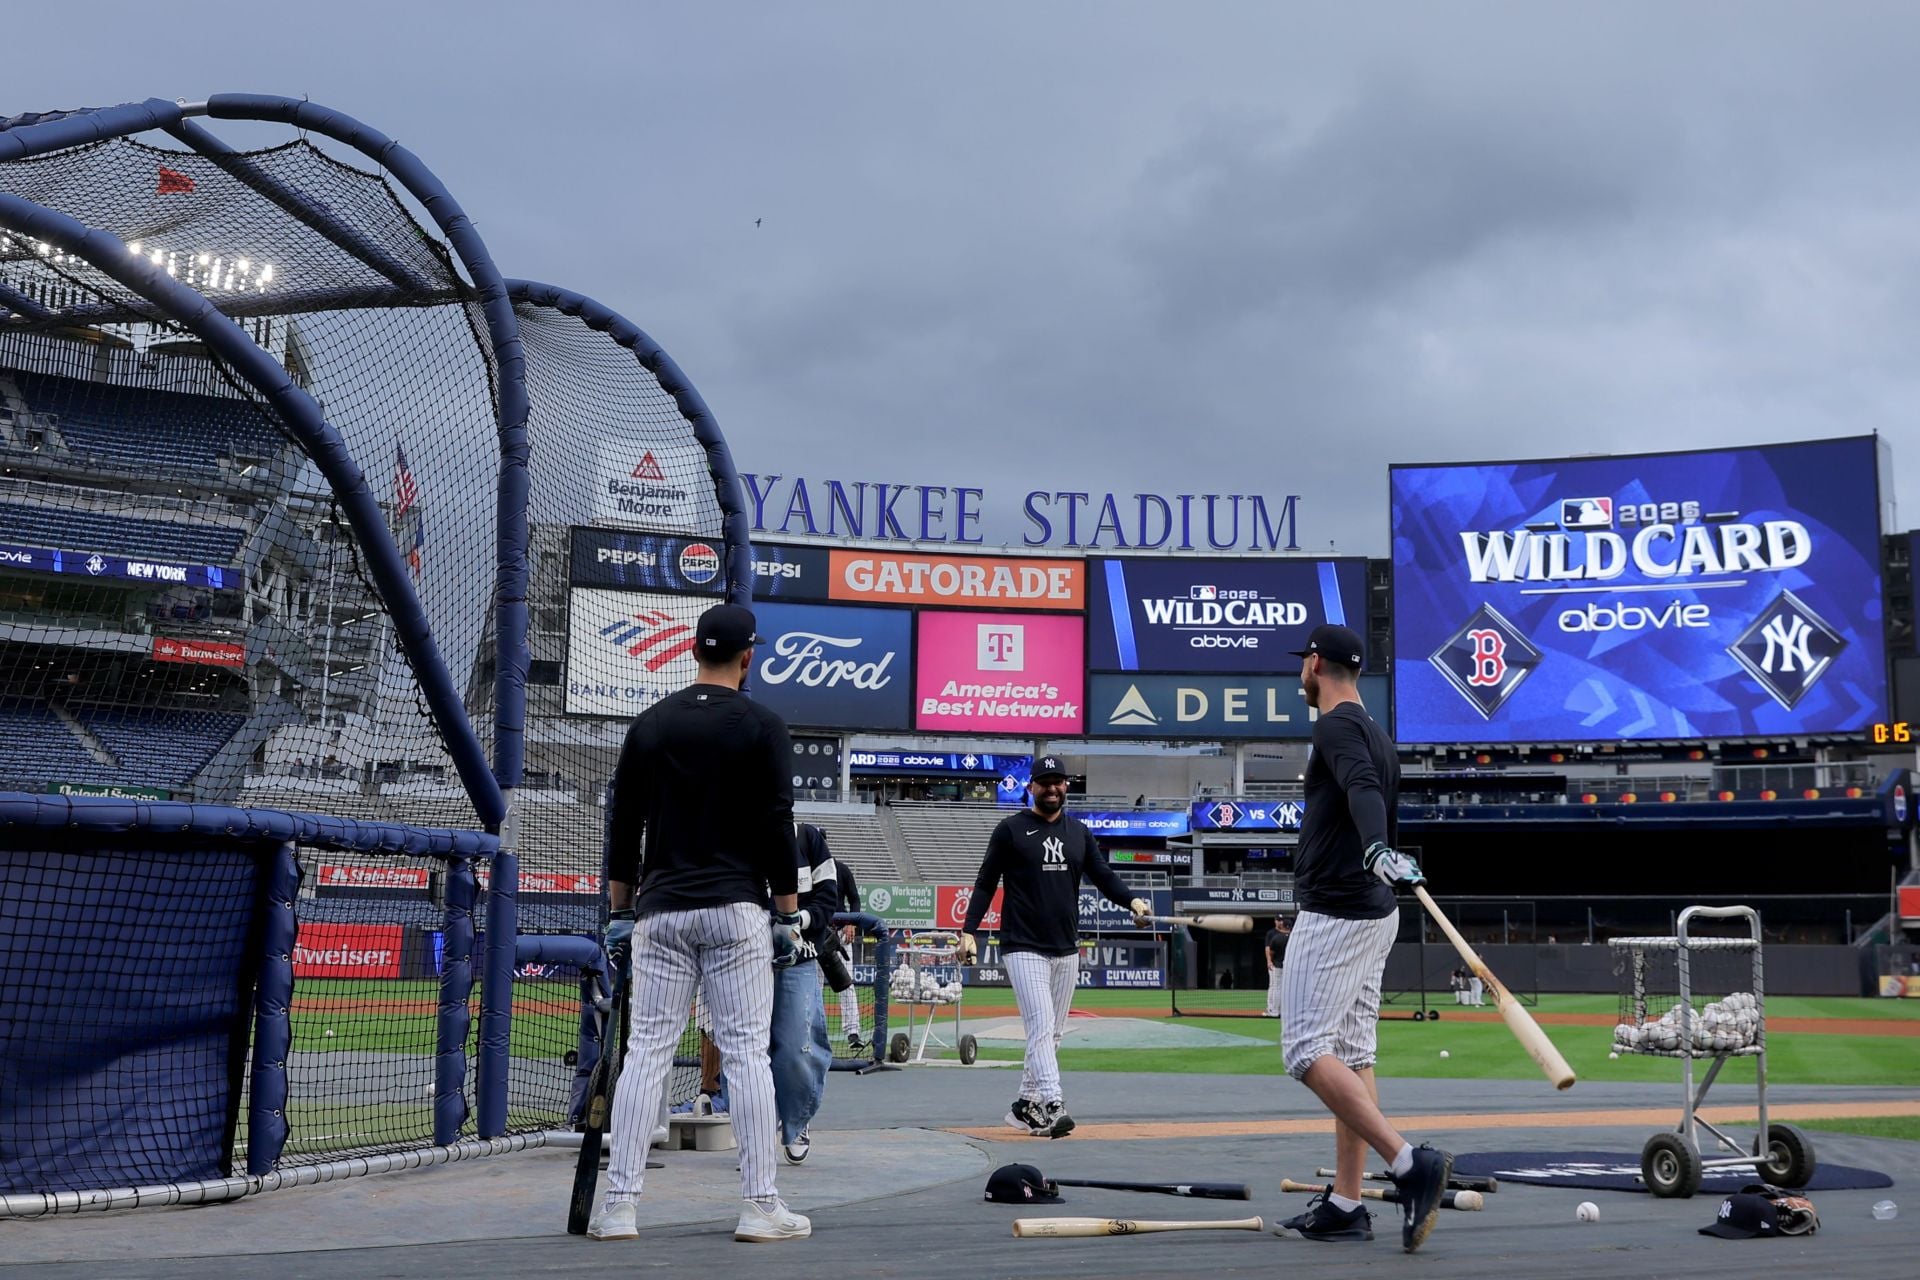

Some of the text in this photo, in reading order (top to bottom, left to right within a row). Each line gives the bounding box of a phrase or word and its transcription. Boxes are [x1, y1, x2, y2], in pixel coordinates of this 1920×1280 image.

[608, 479, 686, 501] Benjamin
[617, 497, 672, 517] Moore
[738, 473, 1303, 551] YANKEE STADIUM
[1619, 501, 1701, 524] 2026
[597, 547, 656, 566] PEPSI
[681, 557, 717, 569] PEPSI
[127, 562, 187, 581] NEW YORK
[845, 559, 1074, 600] GATORADE
[1218, 590, 1258, 599] 2026
[1558, 601, 1711, 633] abbvie
[1190, 634, 1258, 648] abbvie
[1760, 614, 1818, 673] NY
[760, 632, 895, 690] Ford
[570, 682, 618, 698] BANK
[624, 687, 646, 699] OF
[940, 681, 1058, 699] America's
[921, 699, 1078, 719] Best Network
[1873, 722, 1910, 744] 0:15
[903, 756, 944, 766] abbvie
[1148, 820, 1179, 828] abbvie
[1249, 809, 1266, 820] VS
[351, 869, 419, 885] State Farm
[979, 969, 999, 981] 399
[1106, 970, 1160, 981] CUTWATER
